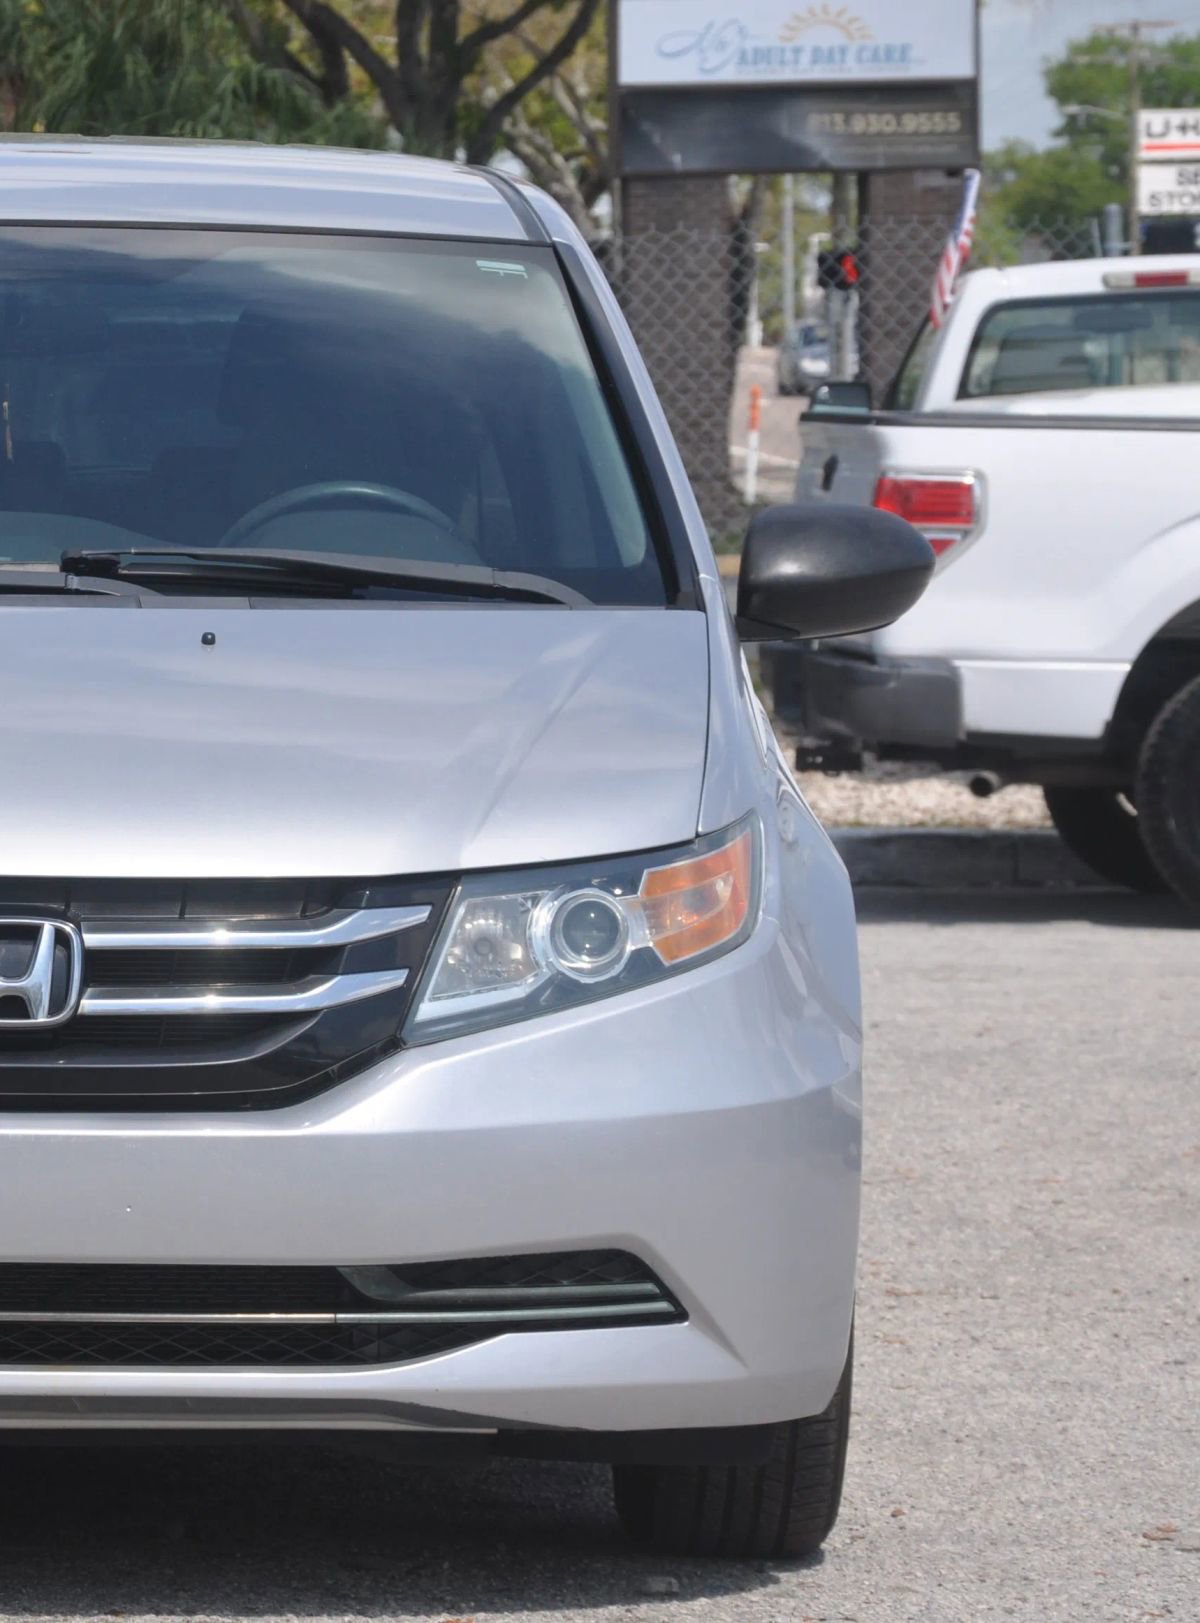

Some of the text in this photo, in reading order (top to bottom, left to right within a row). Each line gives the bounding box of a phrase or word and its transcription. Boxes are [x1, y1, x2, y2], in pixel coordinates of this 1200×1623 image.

[736, 43, 912, 66] ADULT DAY CARE
